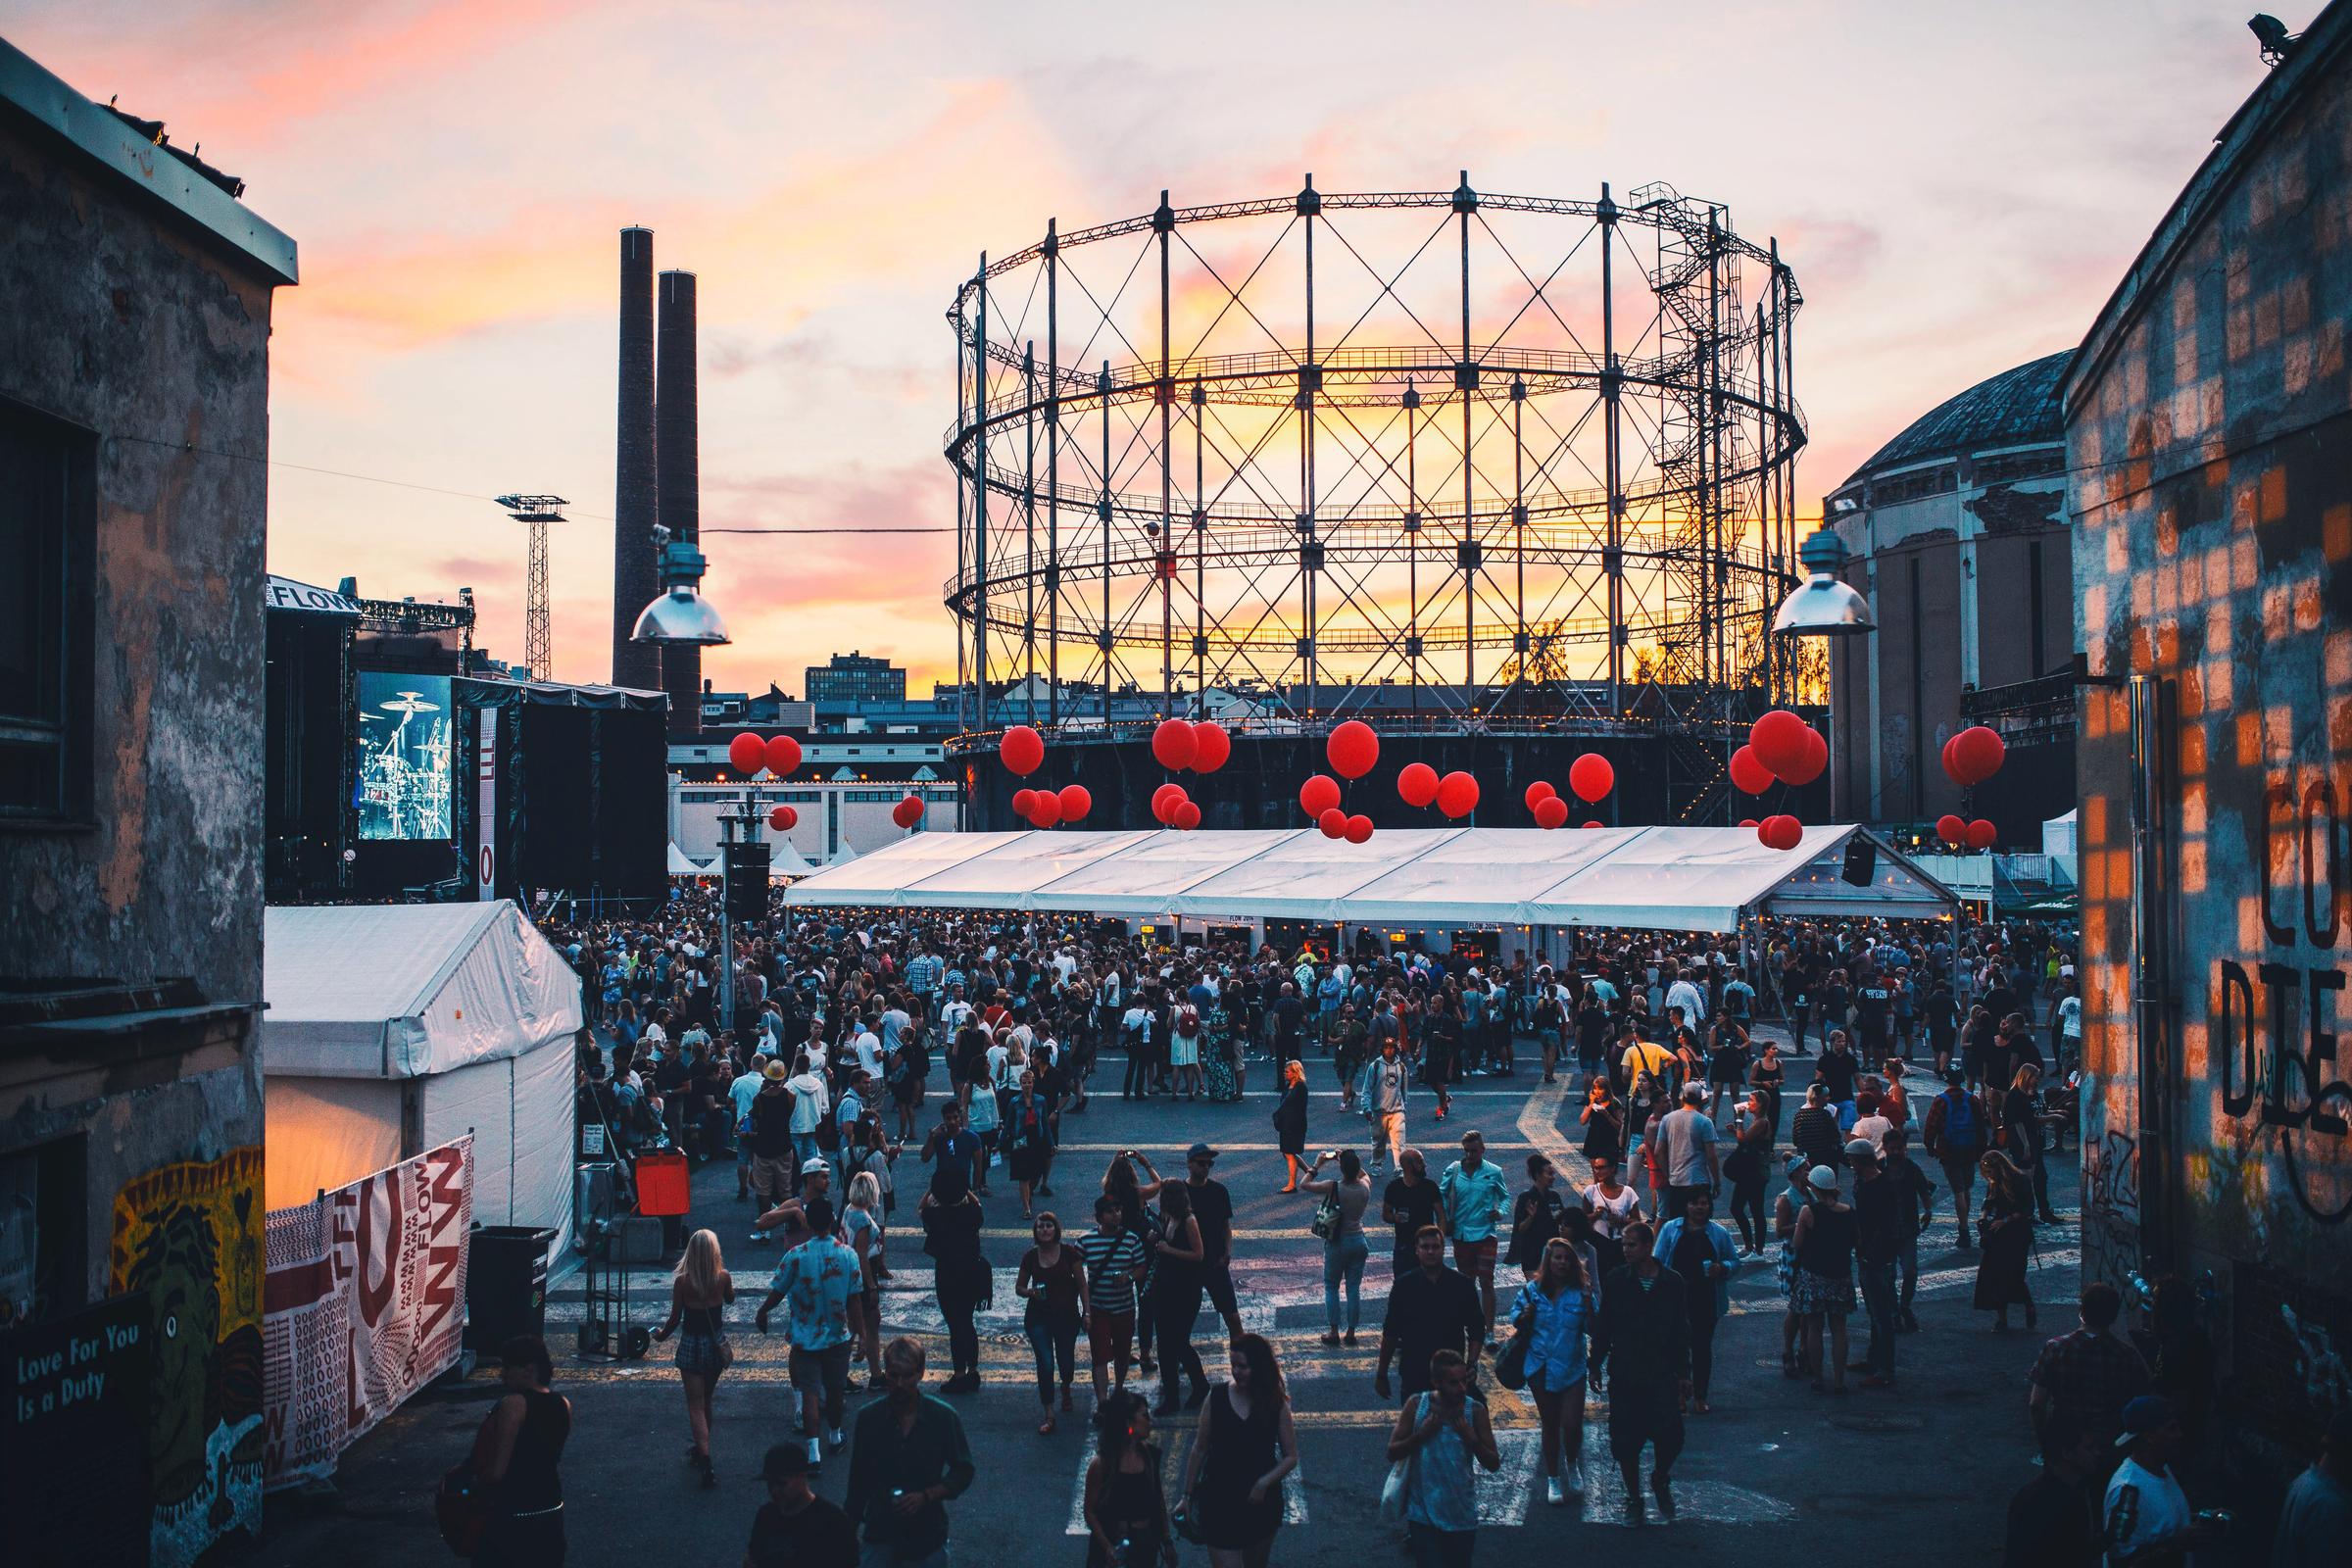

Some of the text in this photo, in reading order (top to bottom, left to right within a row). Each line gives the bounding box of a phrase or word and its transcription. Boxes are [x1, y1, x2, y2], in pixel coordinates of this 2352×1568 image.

[272, 586, 356, 611] FLOW
[2261, 780, 2352, 949] CO
[416, 1162, 434, 1251] FLOW
[18, 1324, 139, 1386] Love For You
[18, 1371, 106, 1423] Is a Duty
